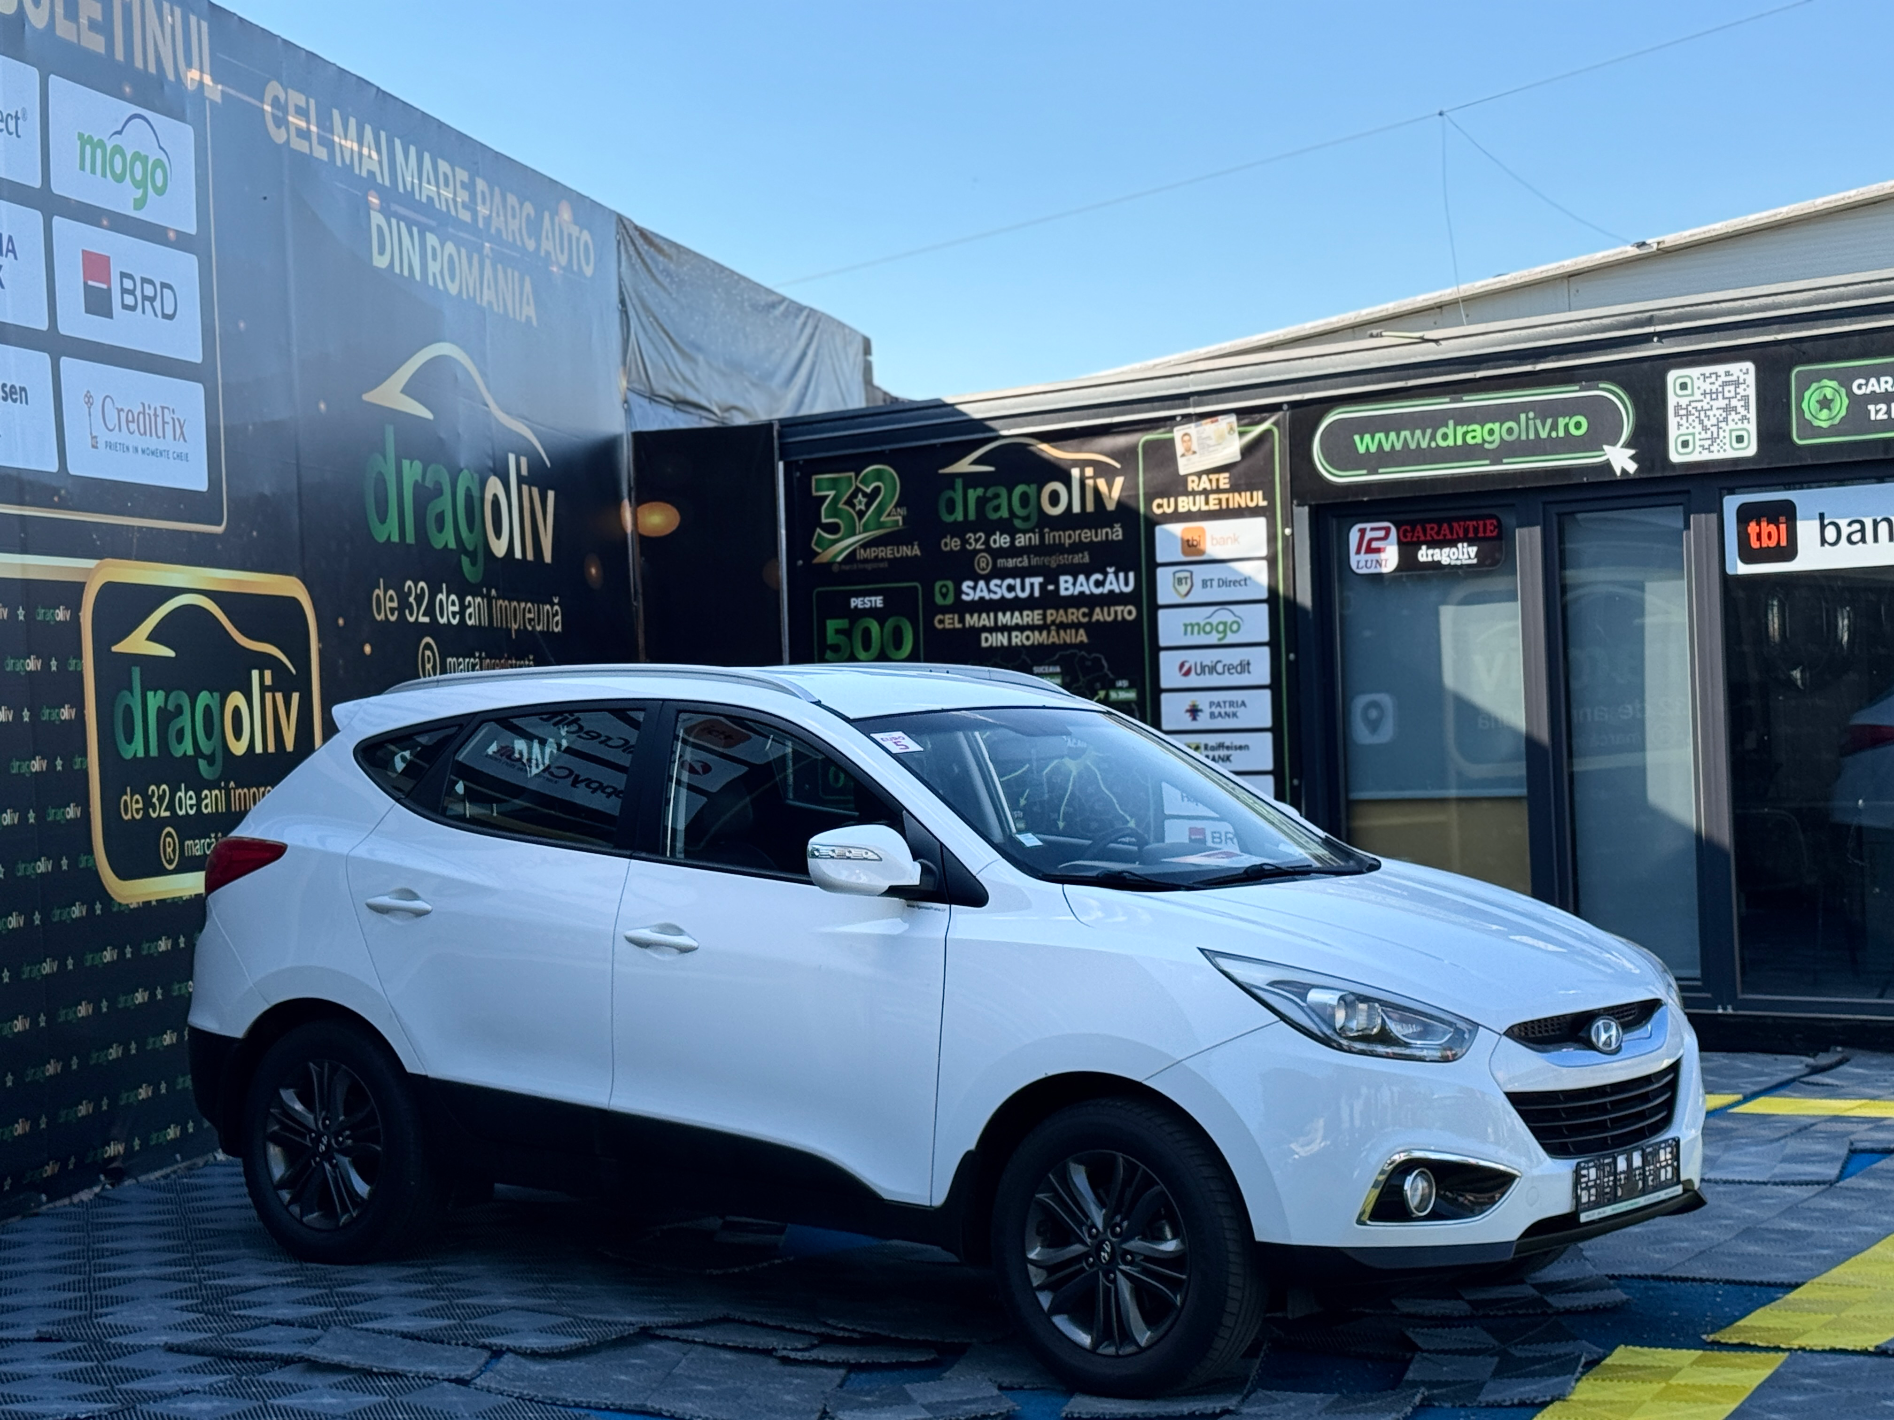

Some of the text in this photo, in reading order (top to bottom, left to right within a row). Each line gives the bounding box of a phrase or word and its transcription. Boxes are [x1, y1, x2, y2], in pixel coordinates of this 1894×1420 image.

[77, 131, 168, 211] mogo
[263, 80, 595, 278] CEL MAI MARE PARC AUTO
[370, 208, 537, 327] DIN ROMÂNIA
[120, 271, 178, 321] BRD
[1852, 376, 1894, 395] GAR
[101, 395, 187, 443] CreditFix
[1867, 403, 1888, 420] 12
[1353, 411, 1588, 454] www.dragoliv.ro
[104, 441, 188, 462] PRIETEN IN MOMENTE CHEIE
[1187, 473, 1230, 491] RATE
[364, 424, 555, 583] dragoliv
[812, 464, 901, 553] 32
[938, 467, 1124, 529] dragoliv
[1152, 490, 1268, 514] CU BULETINUL
[941, 523, 1123, 551] de 32 de ani împreună
[1210, 534, 1240, 546] bank
[1355, 526, 1391, 555] 12
[1399, 519, 1498, 541] GARANTIE
[1748, 512, 1894, 549] tbi ban
[997, 555, 1028, 567] marcă
[1030, 551, 1090, 567] înregistrată
[1356, 558, 1389, 570] LUNI
[1417, 542, 1478, 565] dragoliv
[961, 576, 1043, 601] SASCUT
[1059, 566, 1135, 596] BACĂU
[1176, 577, 1189, 586] BT
[1201, 578, 1214, 589] BT
[372, 578, 562, 639] de 32 de ani împreună
[850, 596, 884, 609] PESTE
[36, 605, 71, 624] dragoliv
[934, 605, 1136, 629] CEL MAI MARE PARC AUTO
[825, 616, 913, 661] 500
[980, 626, 1088, 648] DIN ROMÂNIA
[1183, 620, 1241, 641] mogo
[4, 655, 42, 675] dragoliv
[1194, 659, 1251, 676] UniCredit
[40, 703, 76, 724] dragoliv
[1209, 700, 1247, 709] PATRIA
[1209, 711, 1239, 719] BANK
[114, 667, 299, 780] dragoliv
[1203, 741, 1250, 752] Raiffeisen
[10, 755, 47, 777] dragoliv
[120, 787, 143, 820] de
[148, 784, 171, 818] 32
[175, 783, 197, 816] de
[201, 781, 226, 814] ani
[46, 803, 81, 823] dragoliv
